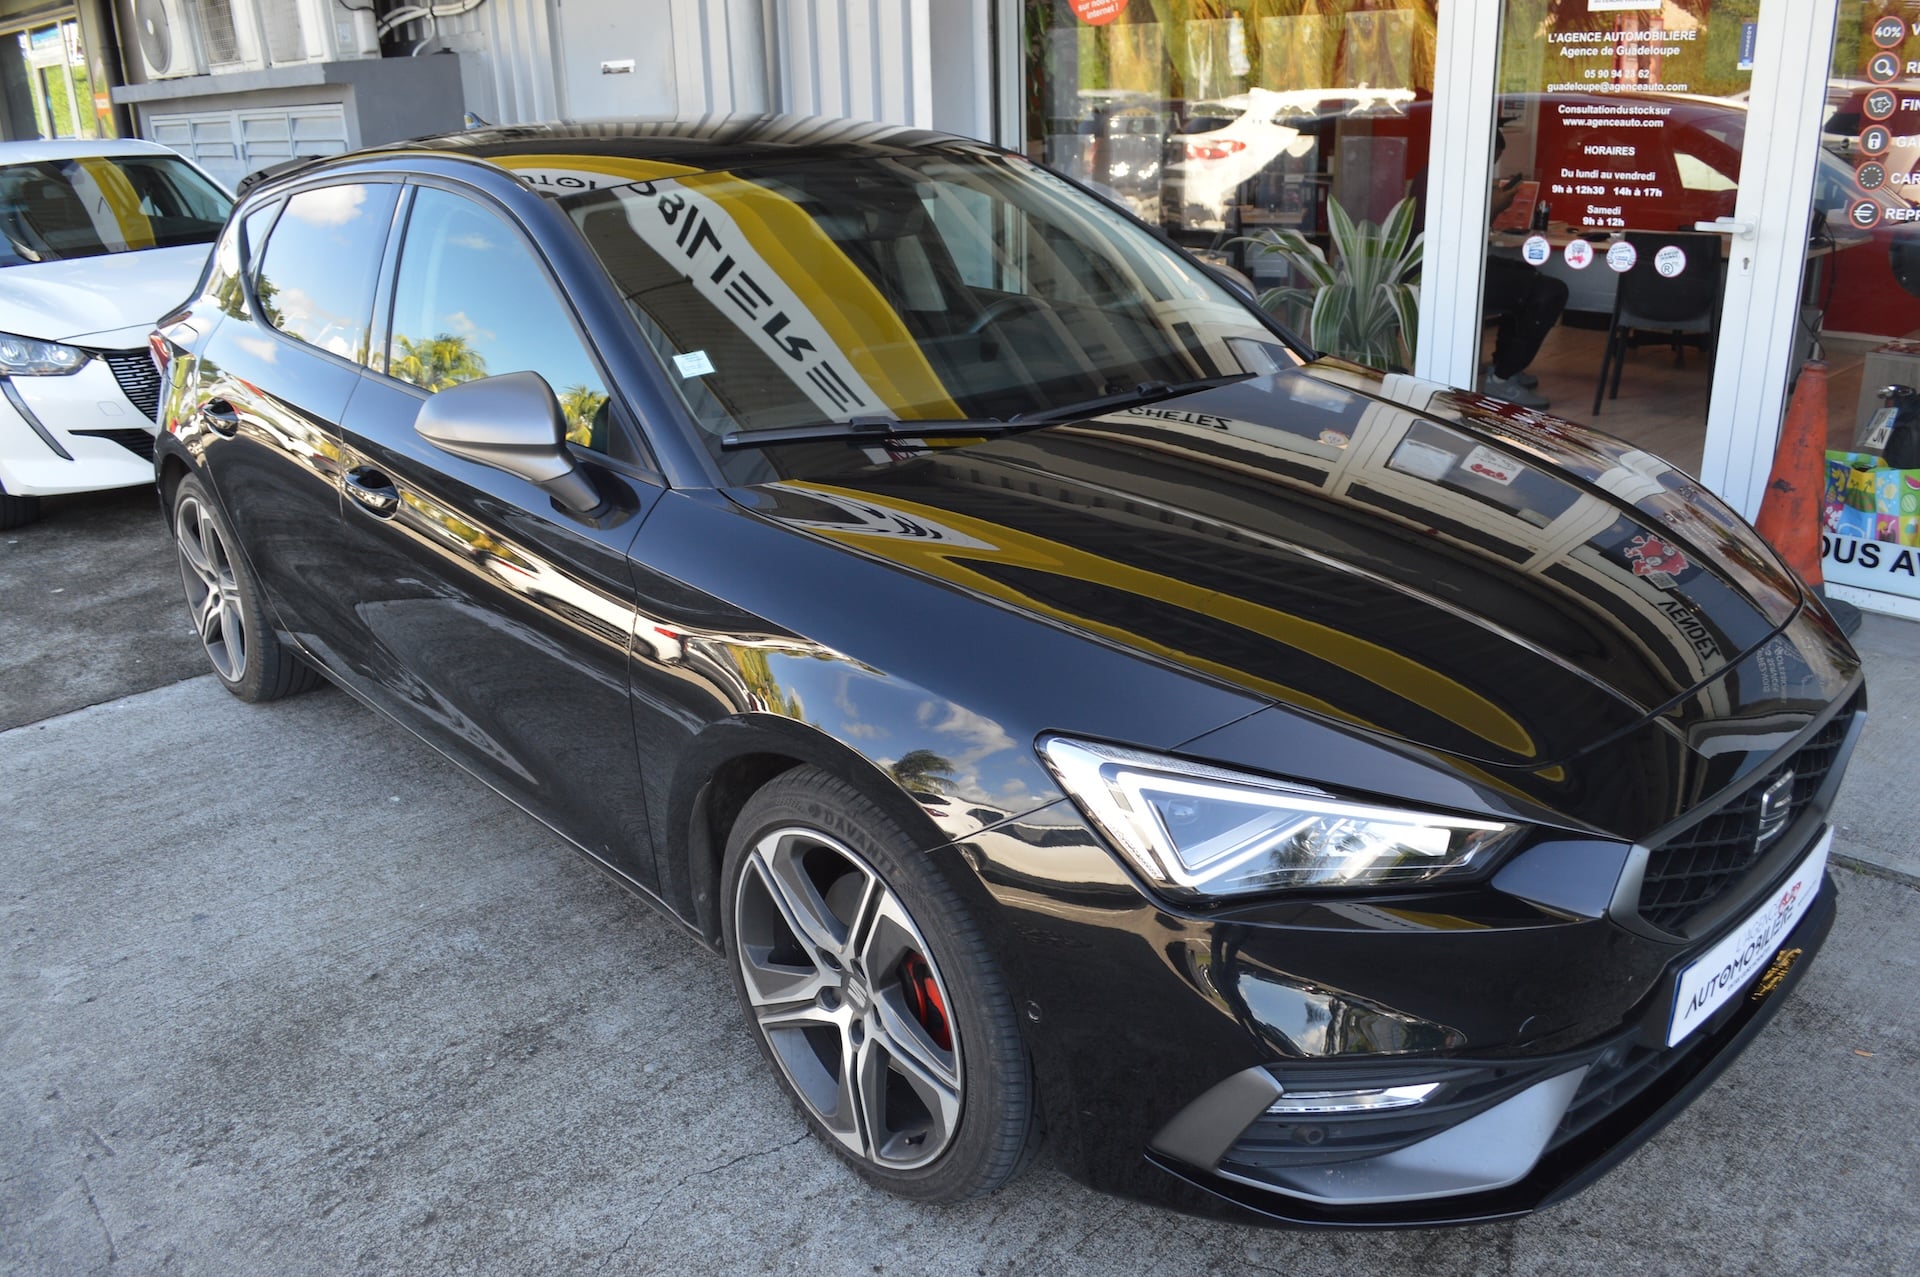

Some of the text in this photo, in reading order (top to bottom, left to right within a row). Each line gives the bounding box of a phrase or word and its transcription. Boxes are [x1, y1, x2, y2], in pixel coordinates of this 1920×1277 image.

[1086, 4, 1115, 19] internet
[1548, 31, 1697, 43] L'AGENCE AUTOMOBILIERE
[1875, 26, 1902, 38] 40%
[1560, 45, 1681, 58] Agence de Guadeloupe
[1905, 61, 1920, 73] R
[1584, 69, 1596, 79] 05
[1598, 69, 1609, 79] 90
[1611, 69, 1622, 79] 94
[1638, 69, 1650, 79] 62
[1547, 82, 1688, 93] guadeloupe@agenceauto.com
[1562, 118, 1664, 128] www.agenceauto.com
[1896, 136, 1920, 148] GA
[1584, 145, 1635, 156] HORAIRES
[1561, 168, 1656, 181] Du lundi au vendredi
[1552, 184, 1663, 197] 9h à 12h30 14h à 17h
[1587, 204, 1621, 215] Samedi
[1582, 216, 1625, 227] 9h à 12h
[1889, 550, 1920, 577] A
